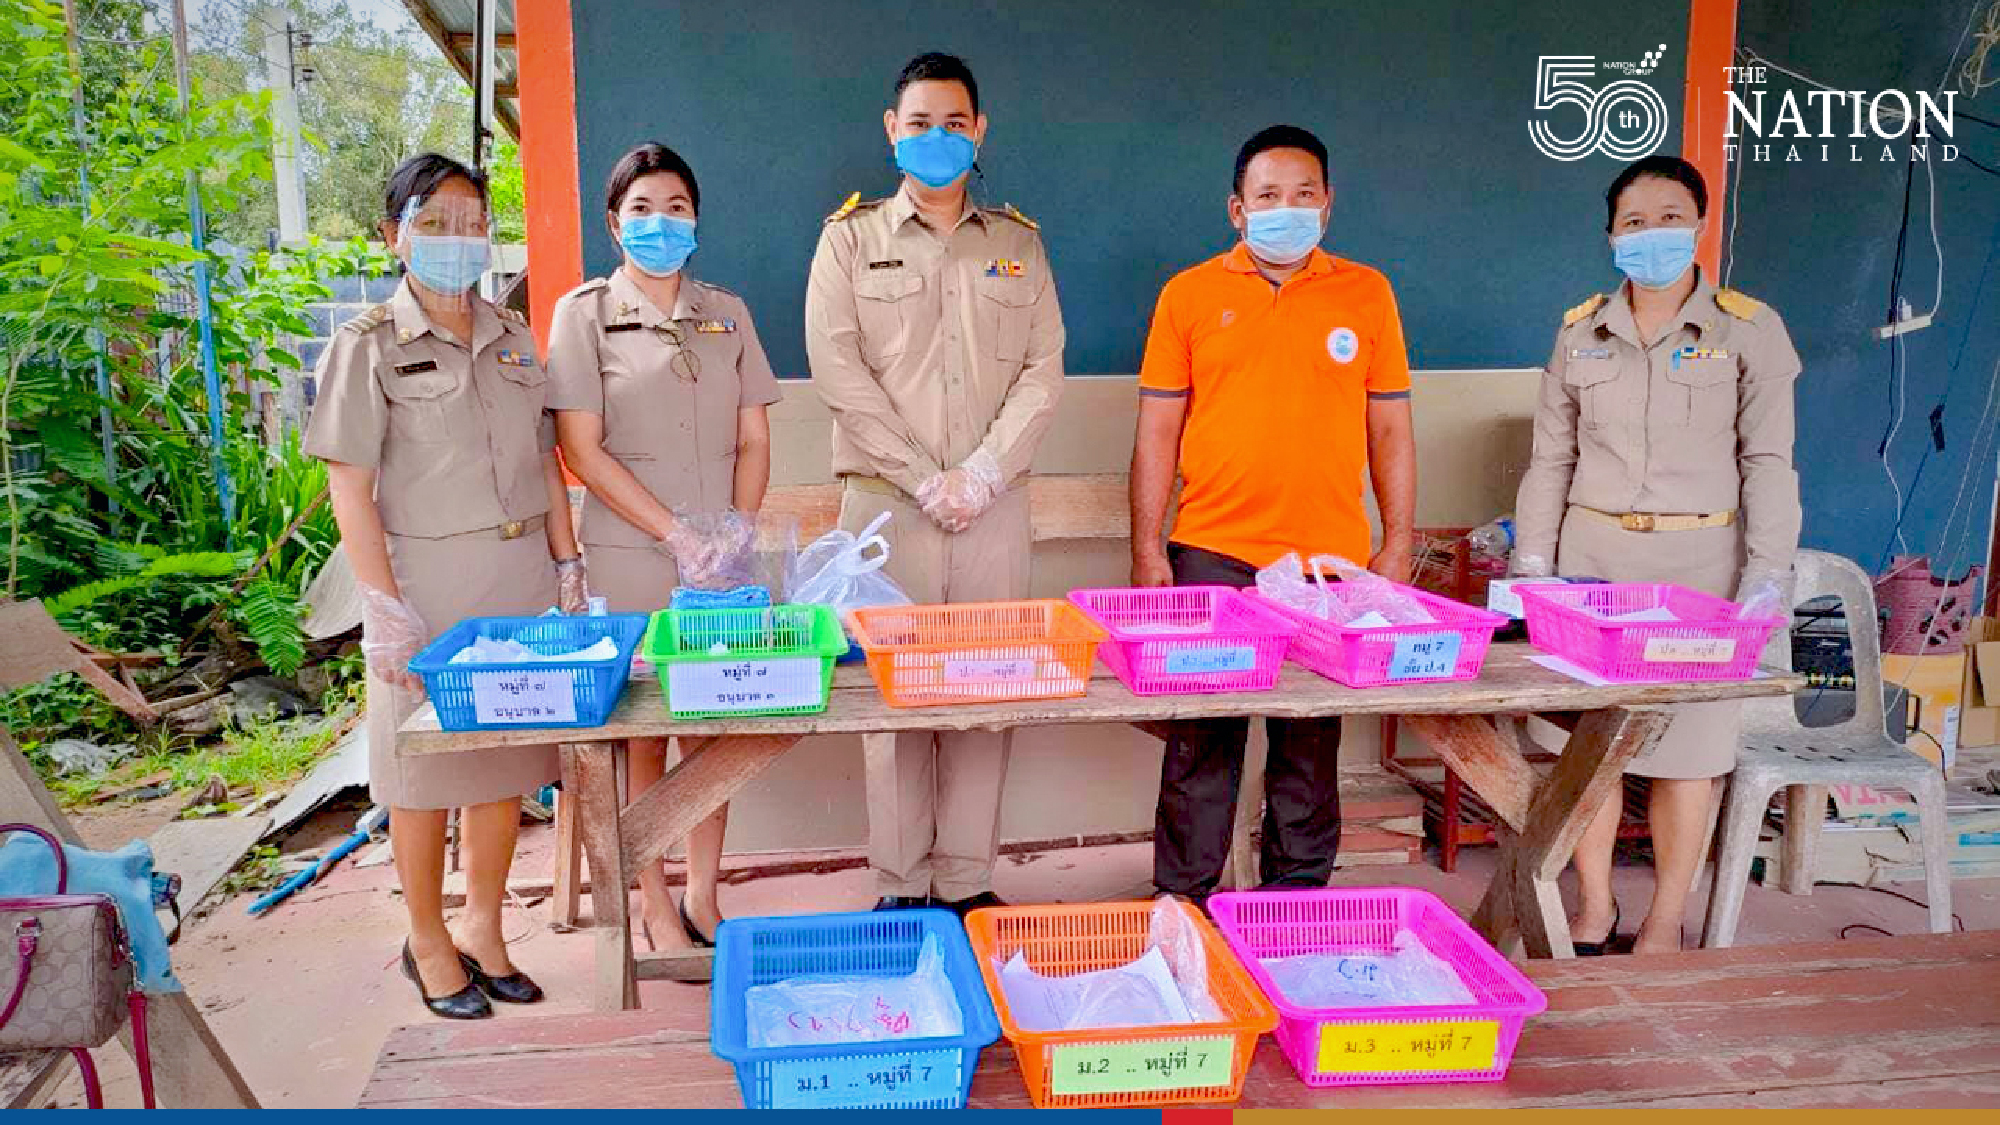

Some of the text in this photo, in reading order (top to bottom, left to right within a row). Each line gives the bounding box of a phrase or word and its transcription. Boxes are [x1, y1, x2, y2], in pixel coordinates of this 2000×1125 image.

[1344, 1038, 1375, 1053] ม.3
[1411, 1027, 1453, 1059] หมู่ที่
[1461, 1036, 1472, 1051] 7
[797, 1074, 829, 1092] ม.1
[866, 1059, 912, 1092] หมู่ที่
[921, 1066, 933, 1082] 7
[1077, 1058, 1110, 1075] ม.2
[1144, 1045, 1188, 1077] หมู่ที่
[1197, 1053, 1209, 1068] 7
